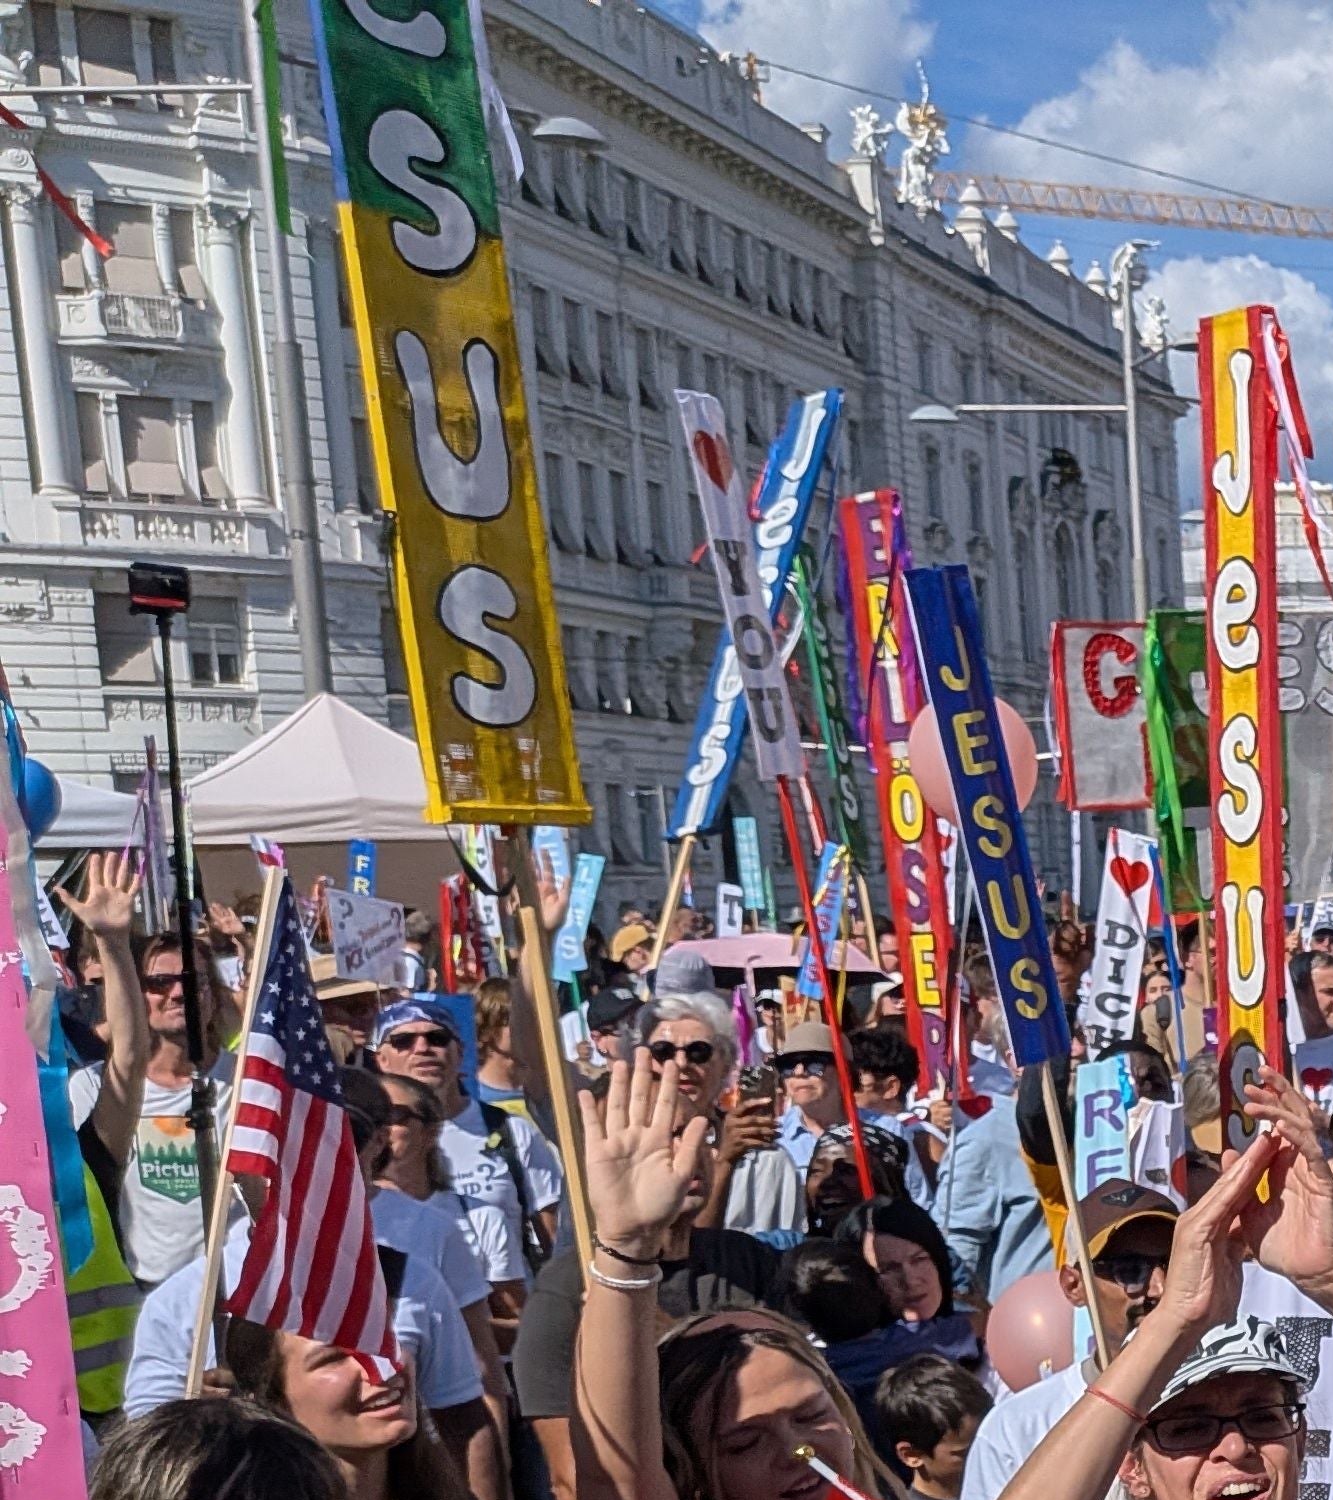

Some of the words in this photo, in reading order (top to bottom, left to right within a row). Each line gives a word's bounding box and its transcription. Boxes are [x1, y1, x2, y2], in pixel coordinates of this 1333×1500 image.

[715, 539, 786, 744] YOU
[940, 625, 1048, 1020] JESUS
[1088, 919, 1139, 1046] DICH
